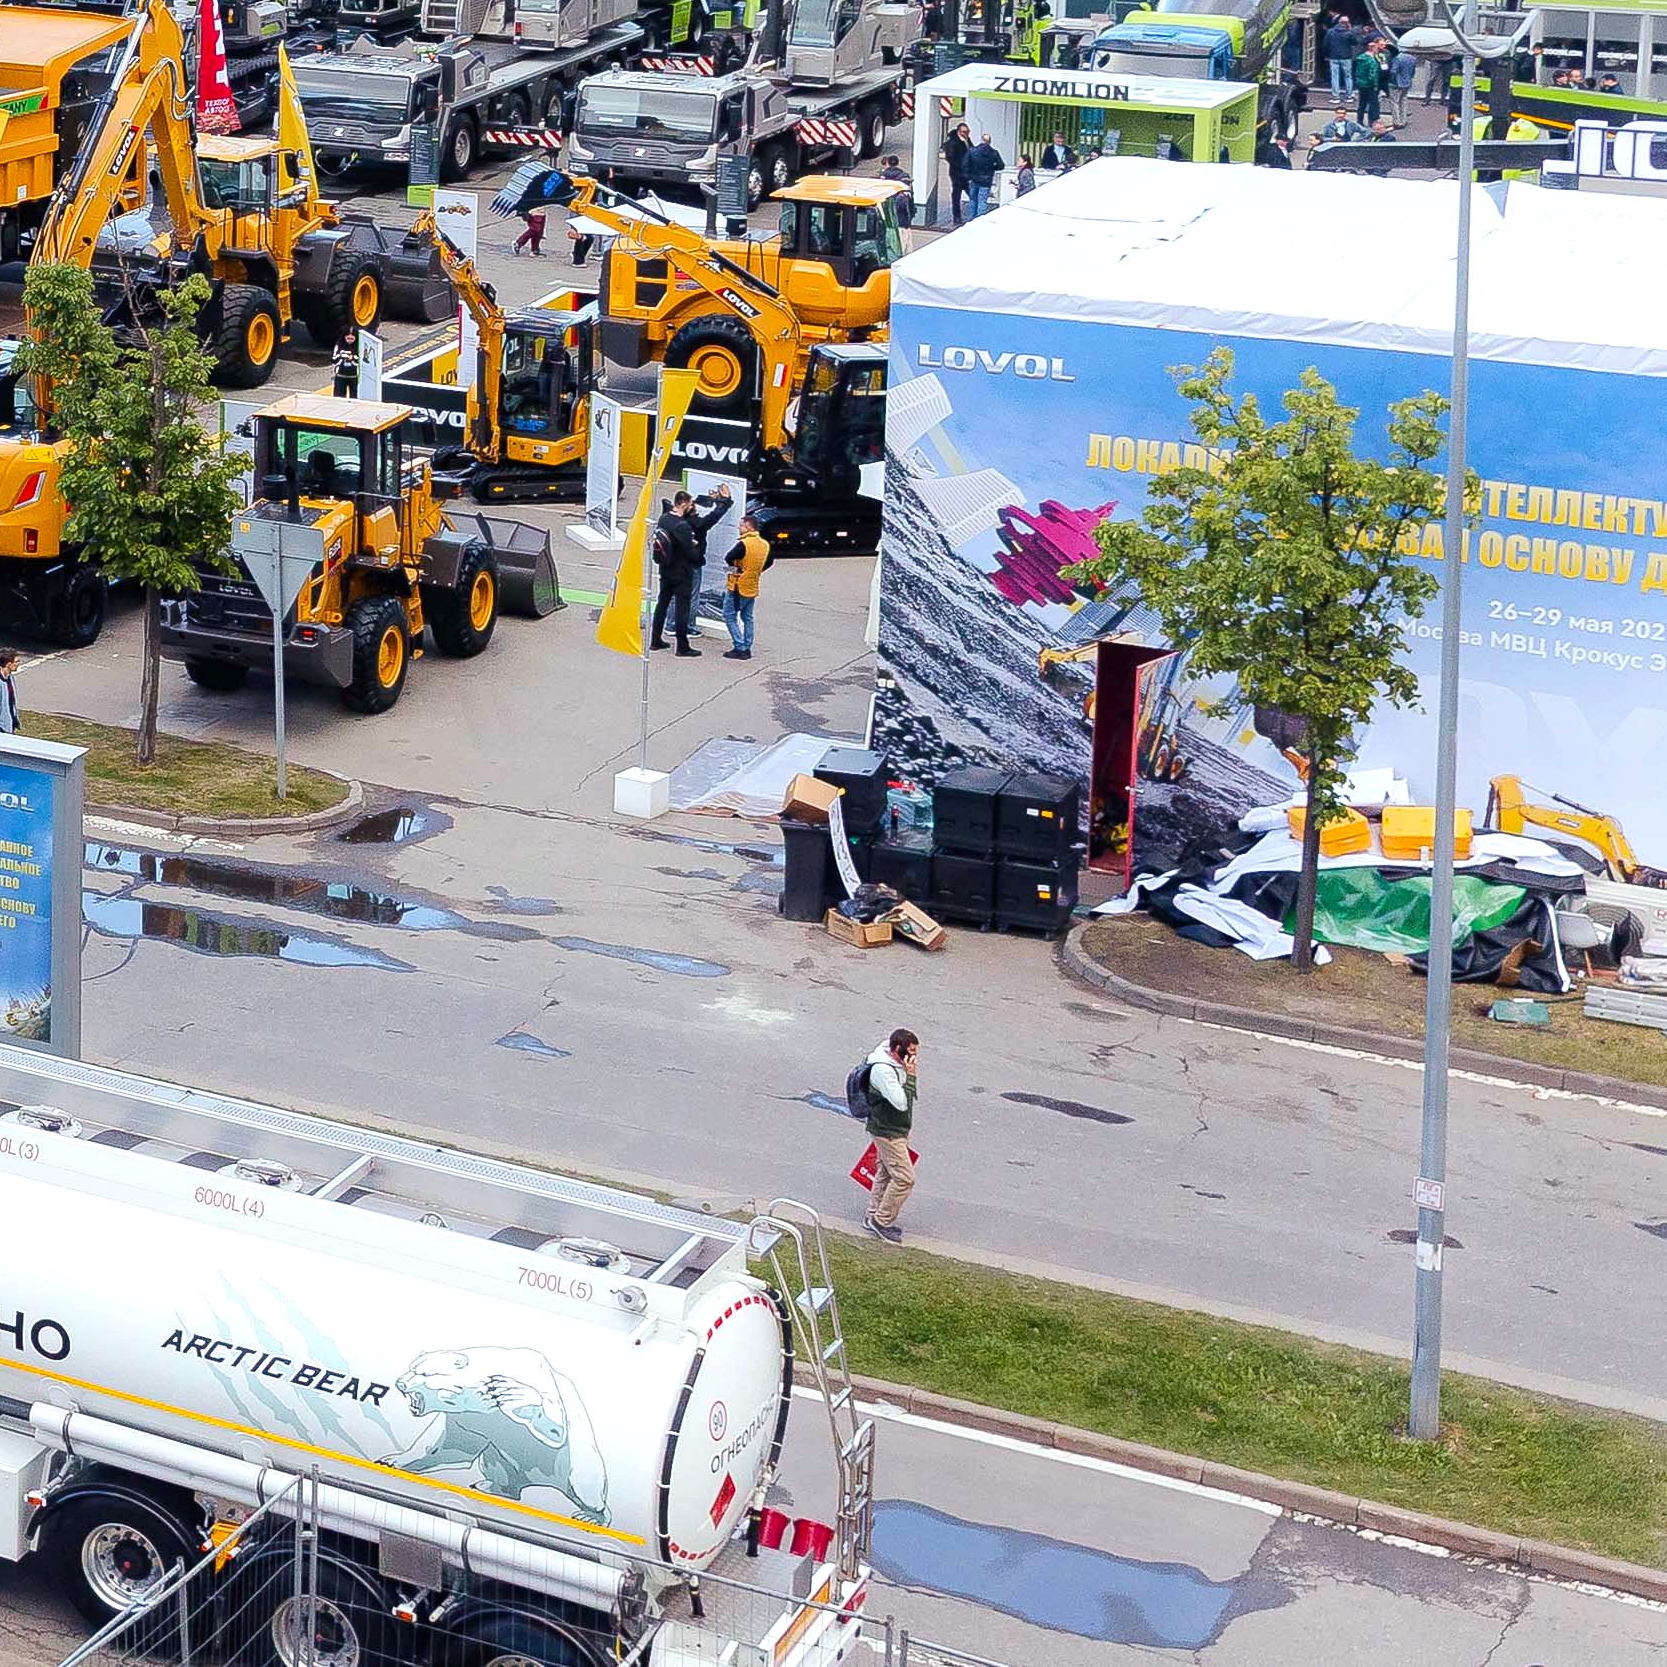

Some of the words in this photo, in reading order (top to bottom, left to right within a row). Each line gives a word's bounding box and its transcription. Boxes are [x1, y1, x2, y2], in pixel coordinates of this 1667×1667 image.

[994, 77, 1129, 101] ZOOMLION
[112, 129, 135, 174] LOVOL
[722, 289, 754, 317] LOVOL
[918, 343, 1076, 383] LOVOL
[1478, 530, 1633, 586] ОСНОВУ
[1488, 600, 1562, 626] 26–29
[1569, 615, 1614, 635] мая
[1399, 617, 1483, 647] Мосва
[1490, 631, 1547, 661] МВЦ
[1554, 640, 1643, 671] Крокус
[194, 1185, 265, 1219] 6000L(4)
[518, 1266, 593, 1302] 7000L(5)
[161, 1329, 292, 1379] ARCTIC
[291, 1364, 390, 1407] BEAR
